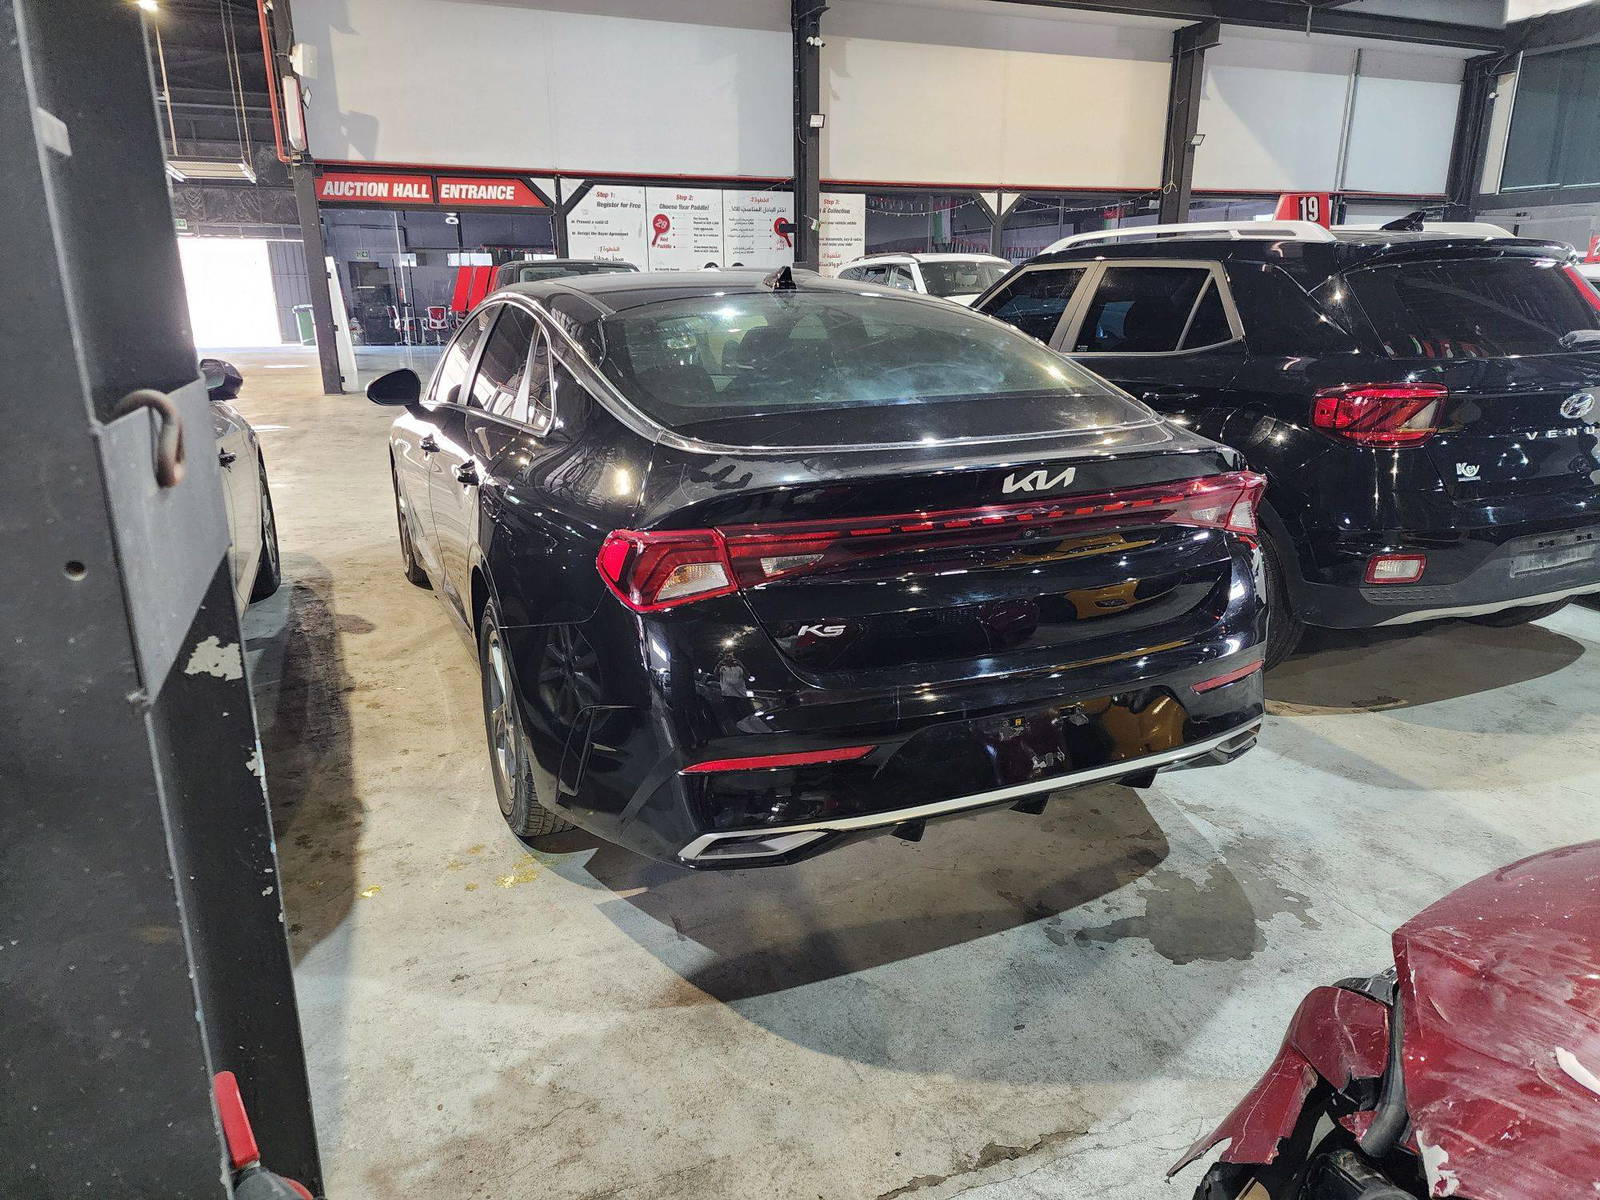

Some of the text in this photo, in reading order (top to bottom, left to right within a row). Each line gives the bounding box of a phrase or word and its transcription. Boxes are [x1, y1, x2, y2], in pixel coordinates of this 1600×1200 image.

[322, 181, 430, 199] AUCTION HALL
[440, 184, 515, 200] ENTRANCE
[596, 191, 608, 199] Step
[596, 201, 619, 209] Register
[676, 194, 688, 202] Step
[1299, 196, 1319, 222] 19
[1455, 462, 1481, 477] Key
[1002, 467, 1077, 494] KIA
